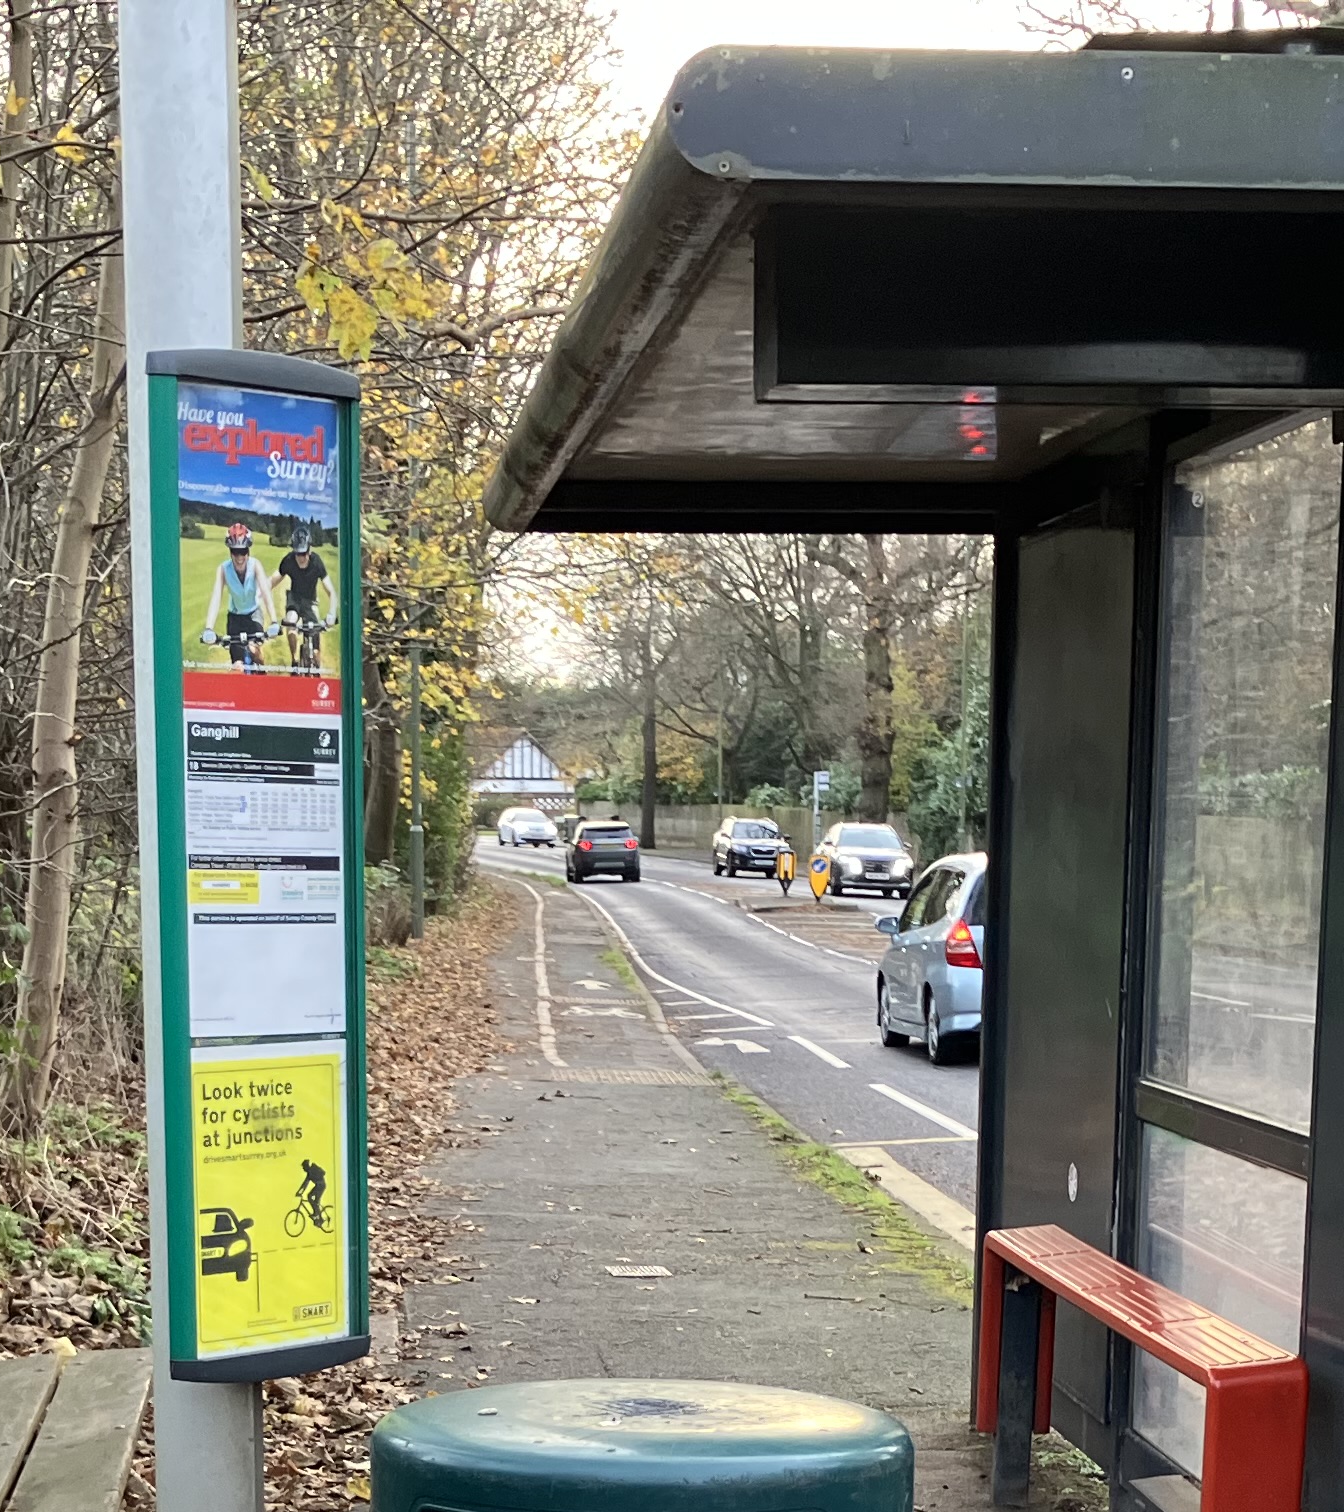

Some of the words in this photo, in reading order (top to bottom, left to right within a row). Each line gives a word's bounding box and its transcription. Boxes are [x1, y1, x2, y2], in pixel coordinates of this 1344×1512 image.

[177, 401, 214, 424] Have
[217, 410, 244, 430] you
[183, 418, 325, 466] explored
[267, 451, 335, 491] Surrey?
[190, 723, 240, 741] Ganghill
[202, 1081, 243, 1101] Look
[249, 1079, 293, 1097] twice
[202, 1107, 226, 1124] for
[233, 1101, 295, 1125] cyclists
[202, 1130, 220, 1148] at
[226, 1126, 303, 1150] junctions
[301, 1304, 330, 1319] SMART
